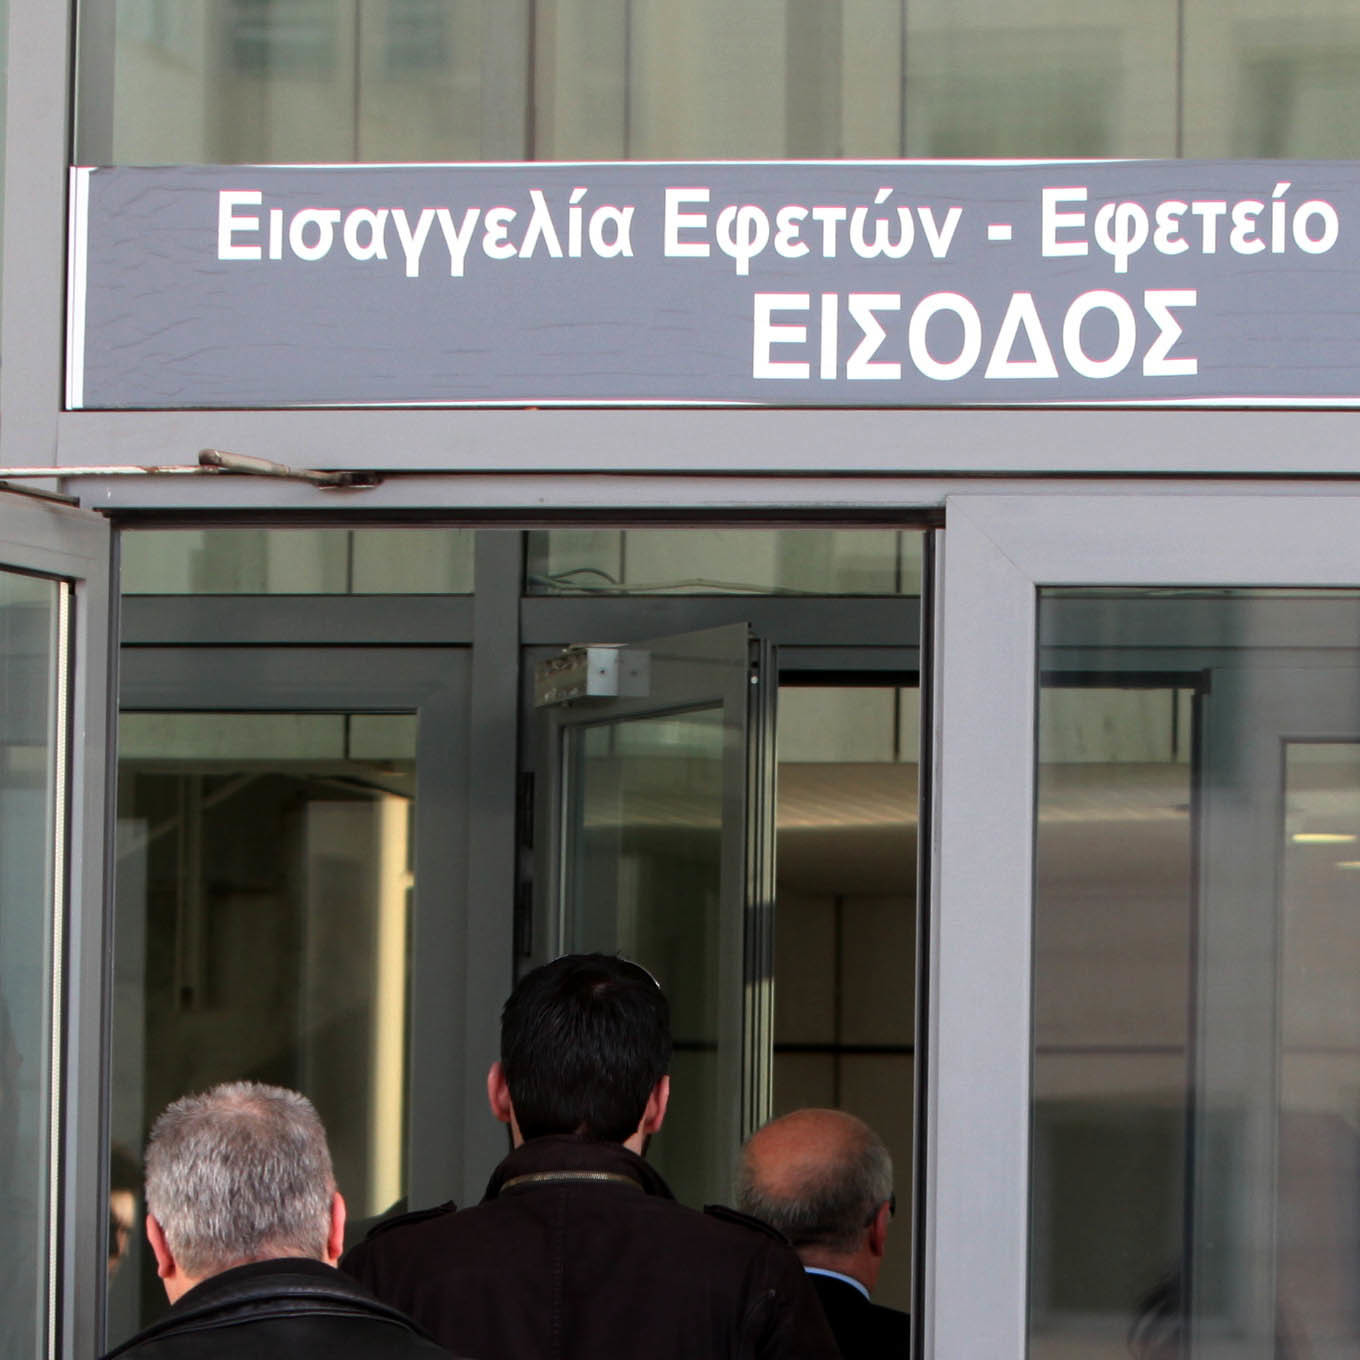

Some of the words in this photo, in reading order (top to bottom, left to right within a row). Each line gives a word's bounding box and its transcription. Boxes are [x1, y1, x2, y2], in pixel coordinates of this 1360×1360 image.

[217, 188, 635, 278] Εισαγγελία
[664, 187, 963, 276] Εφετών
[987, 225, 1012, 241] -
[1041, 182, 1339, 274] Εφετείο
[752, 289, 1198, 381] ΕΙΣΟΔΟΣ
